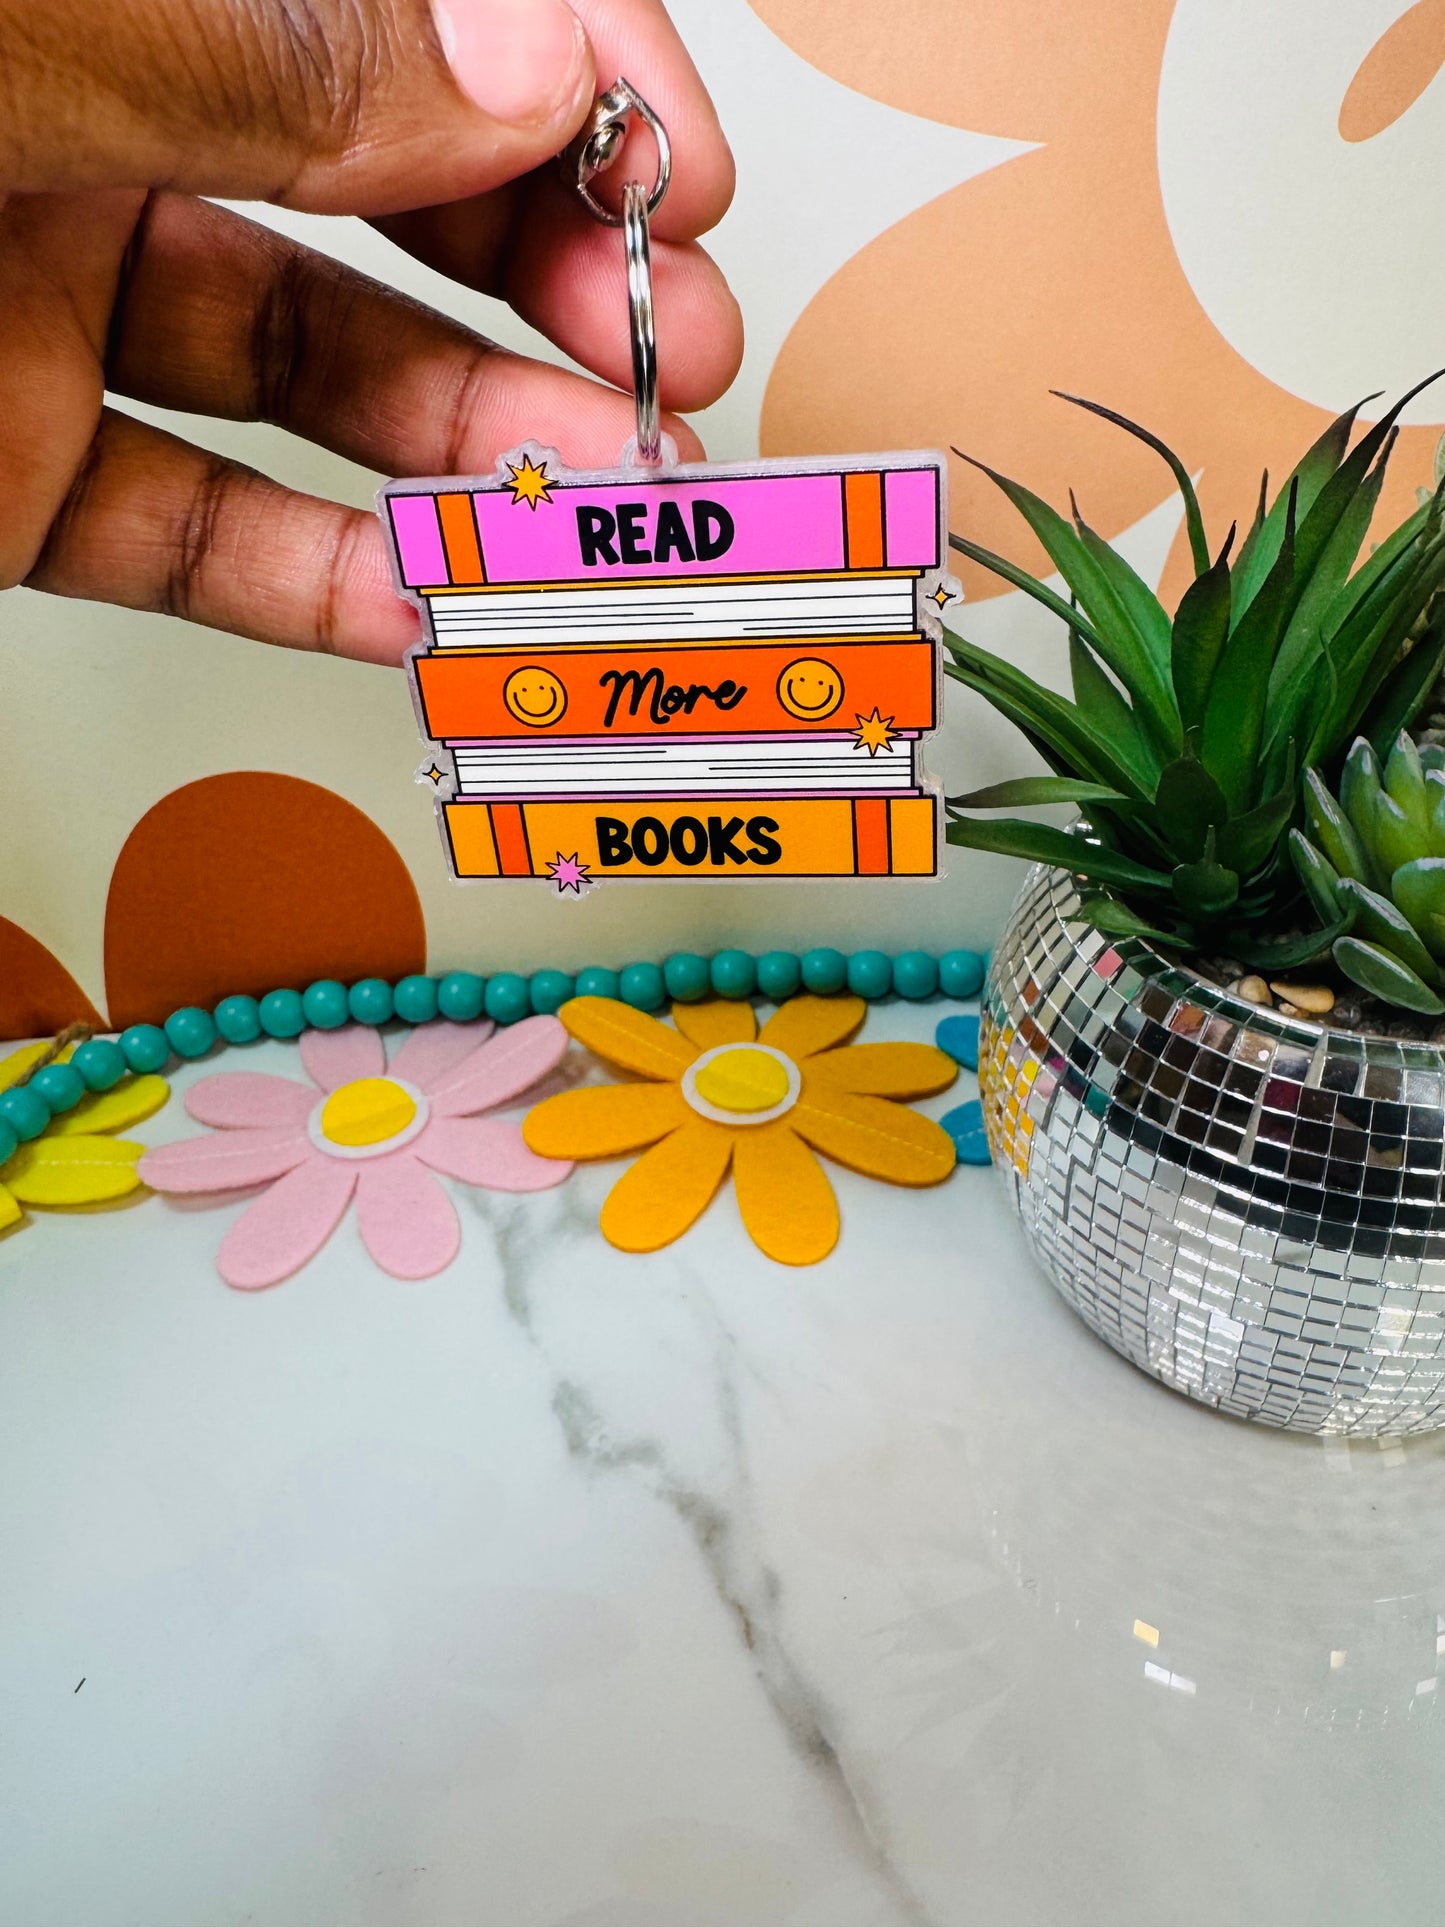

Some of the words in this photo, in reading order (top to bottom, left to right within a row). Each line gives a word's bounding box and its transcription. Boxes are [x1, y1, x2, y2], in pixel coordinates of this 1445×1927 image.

[575, 499, 735, 567] READ
[599, 667, 748, 728] More
[595, 815, 782, 867] BOOKS
